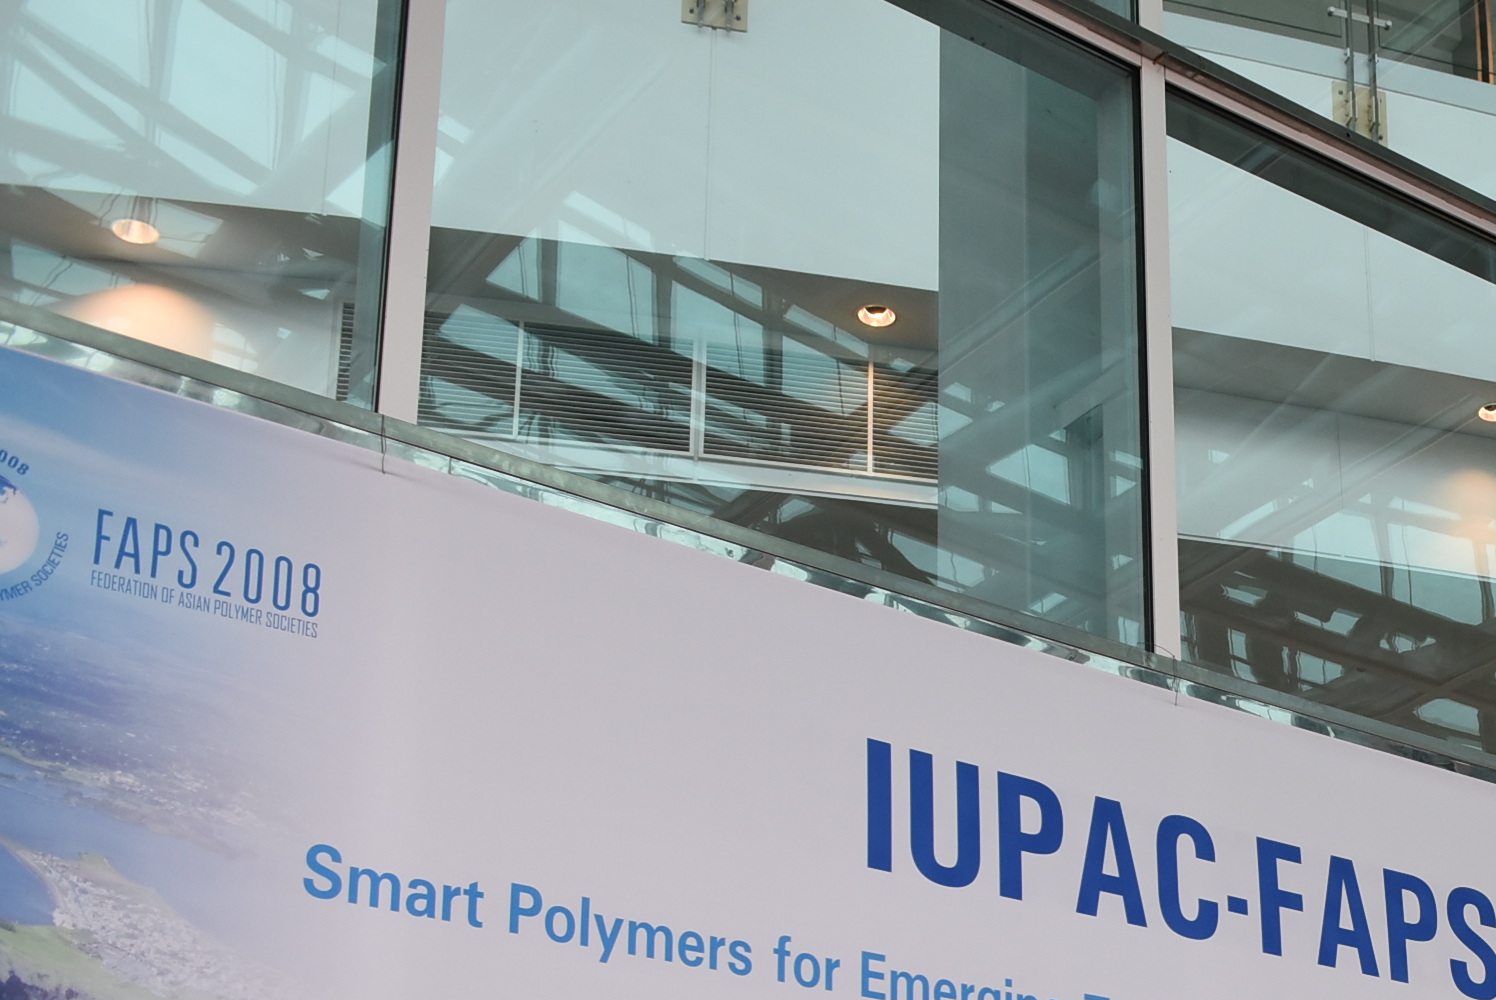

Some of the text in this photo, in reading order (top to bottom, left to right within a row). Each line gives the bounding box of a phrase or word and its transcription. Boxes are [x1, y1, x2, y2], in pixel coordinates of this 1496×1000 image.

[31, 531, 69, 586] SOCIETIES
[93, 508, 322, 618] FAPS 2008
[90, 570, 318, 638] FEDERATION OF ASIAN POLYMER SOCIETIES
[303, 844, 484, 928] Smart
[509, 883, 752, 976] Polymers
[773, 936, 840, 991] for
